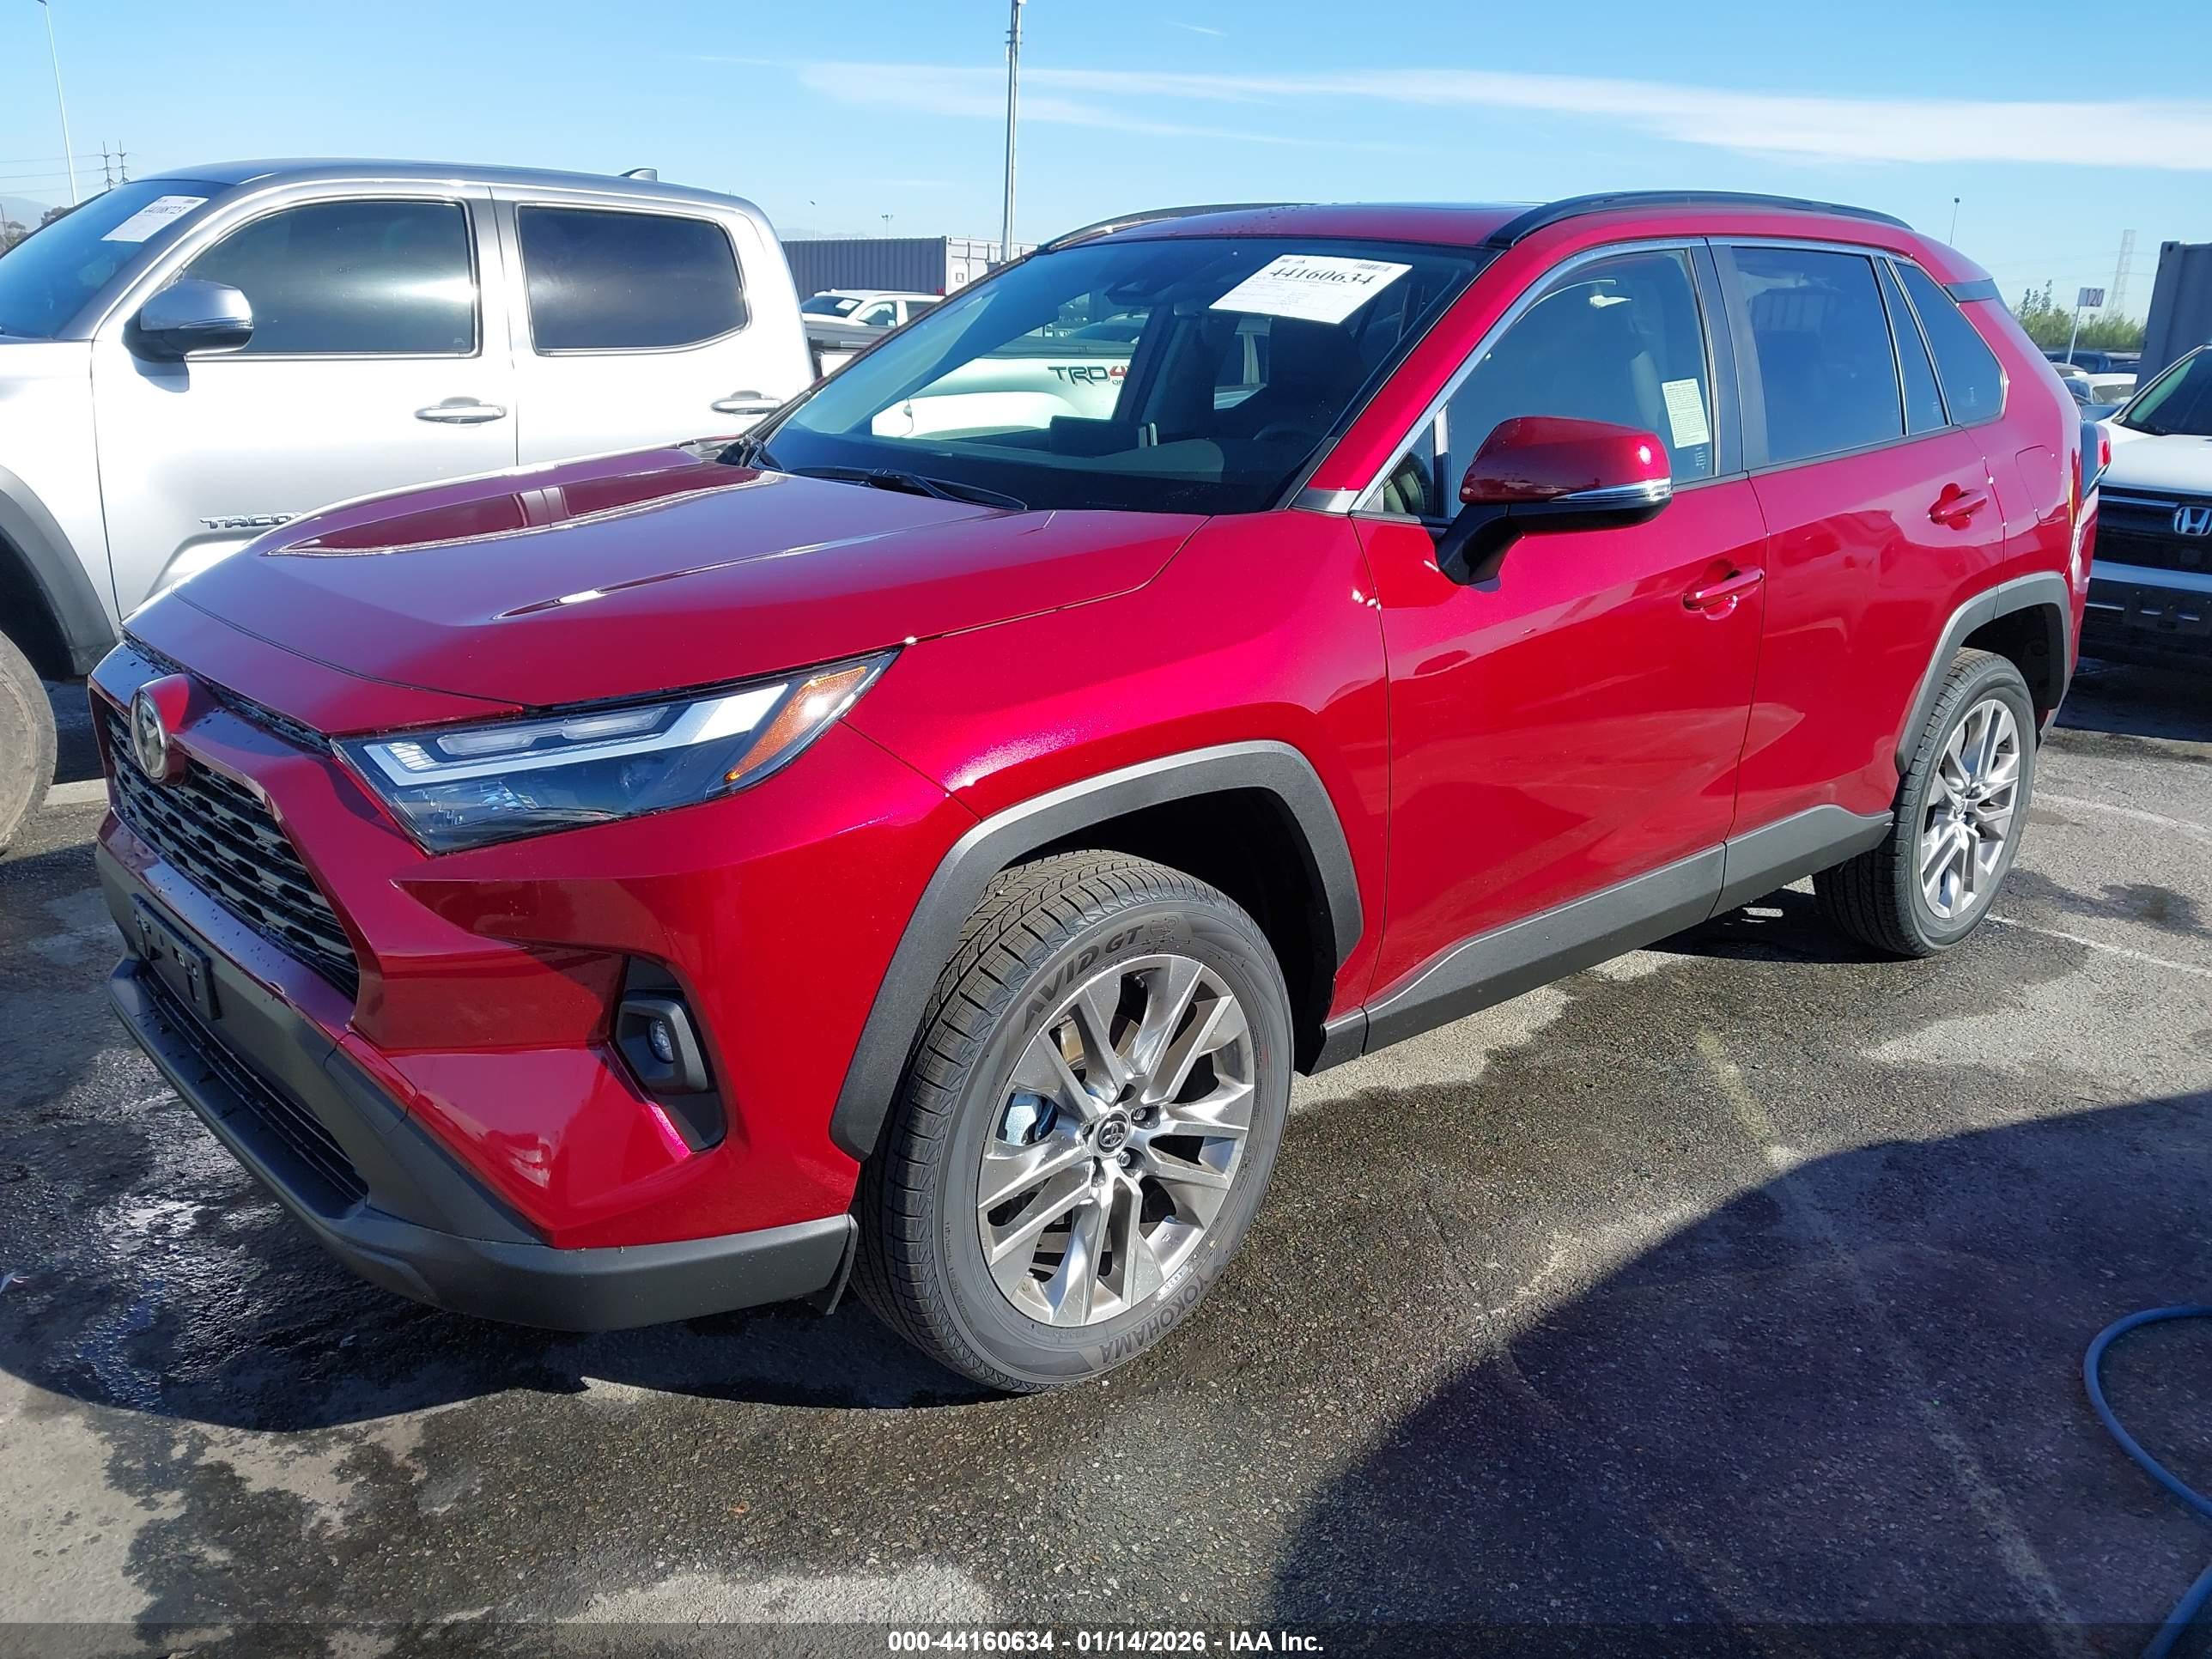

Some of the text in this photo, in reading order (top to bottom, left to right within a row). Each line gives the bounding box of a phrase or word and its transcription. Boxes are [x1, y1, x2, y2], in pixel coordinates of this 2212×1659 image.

[1269, 267, 1376, 285] 44160634
[2086, 288, 2105, 307] 120
[1023, 945, 1100, 1035] AVID
[1105, 924, 1144, 954] GT
[1098, 1274, 1204, 1364] YOKOHAMA
